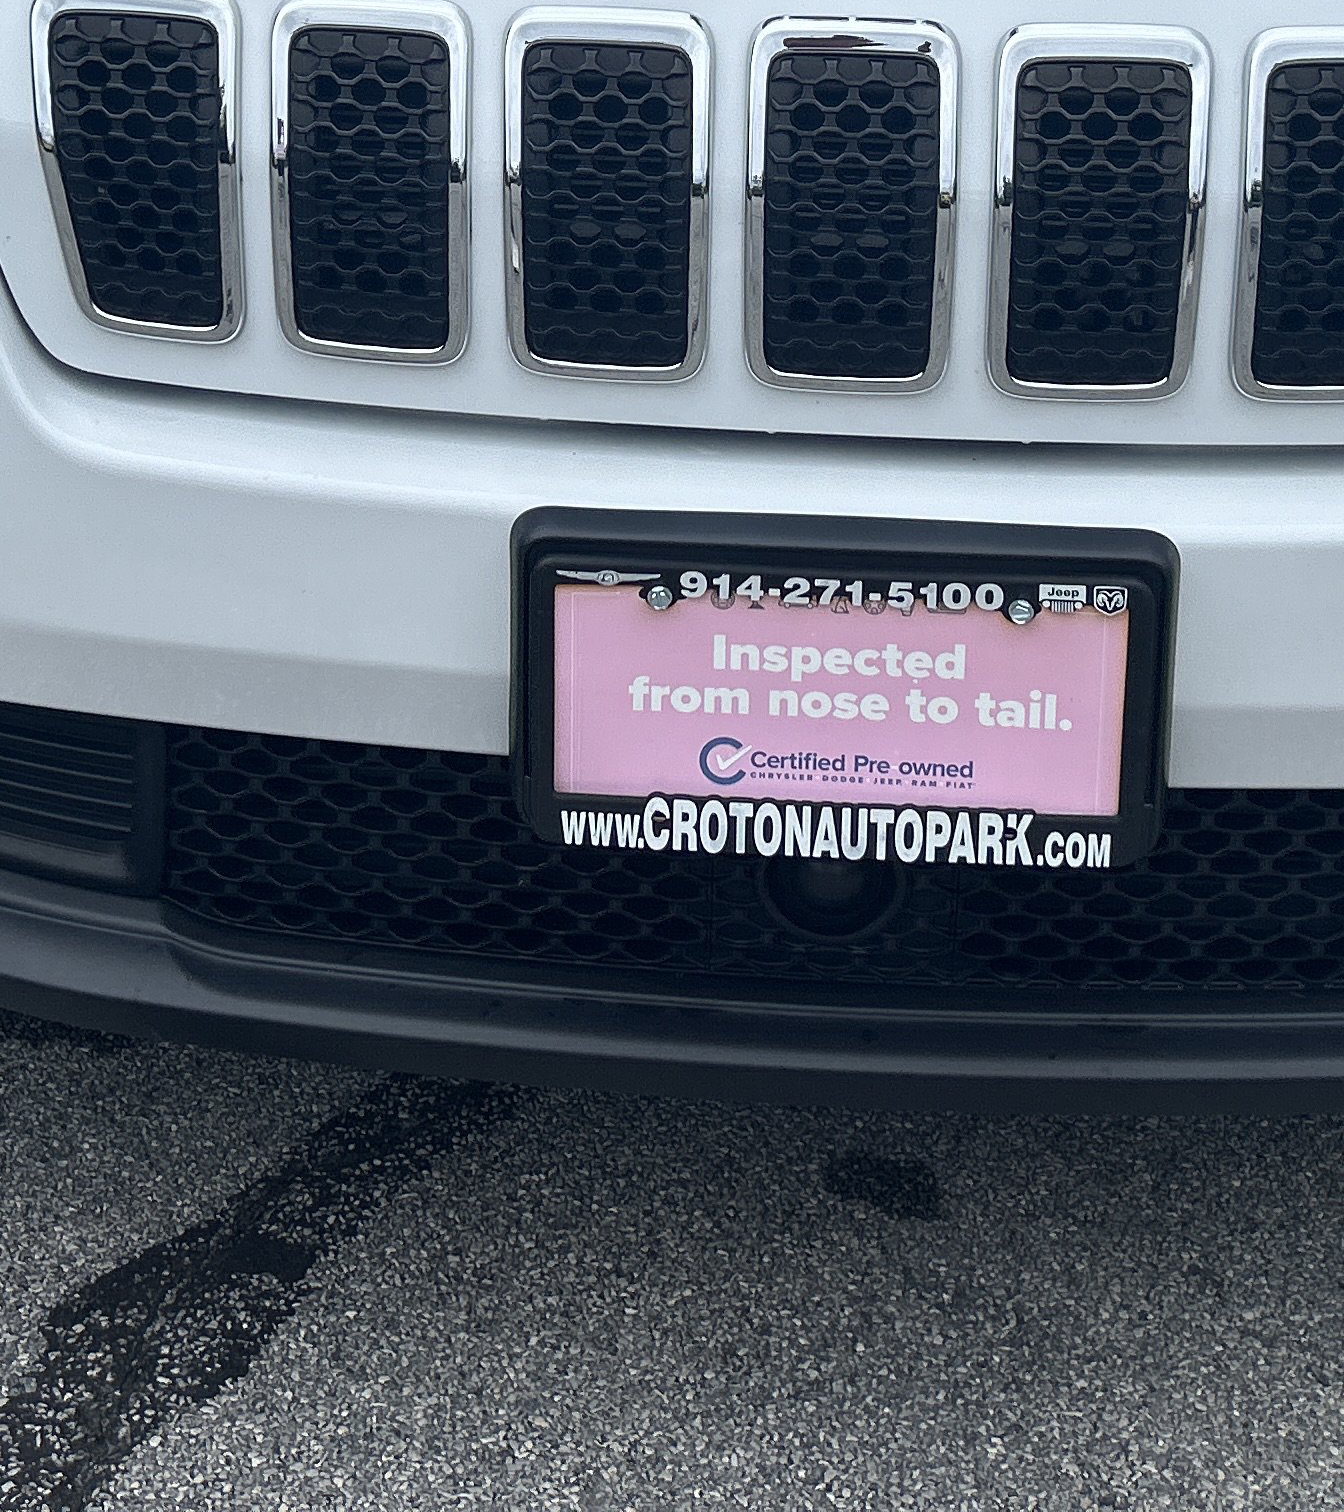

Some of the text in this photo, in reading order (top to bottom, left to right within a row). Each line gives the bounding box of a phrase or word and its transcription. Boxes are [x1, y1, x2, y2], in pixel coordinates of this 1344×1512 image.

[679, 570, 1005, 611] 914-271-5100
[1047, 587, 1080, 598] Jeep
[713, 634, 967, 682] Inspected
[628, 675, 1073, 731] from nose to tail.
[750, 750, 846, 772] Certified
[749, 771, 973, 790] CHRYSLER DODGE JEEP RAM FIAT
